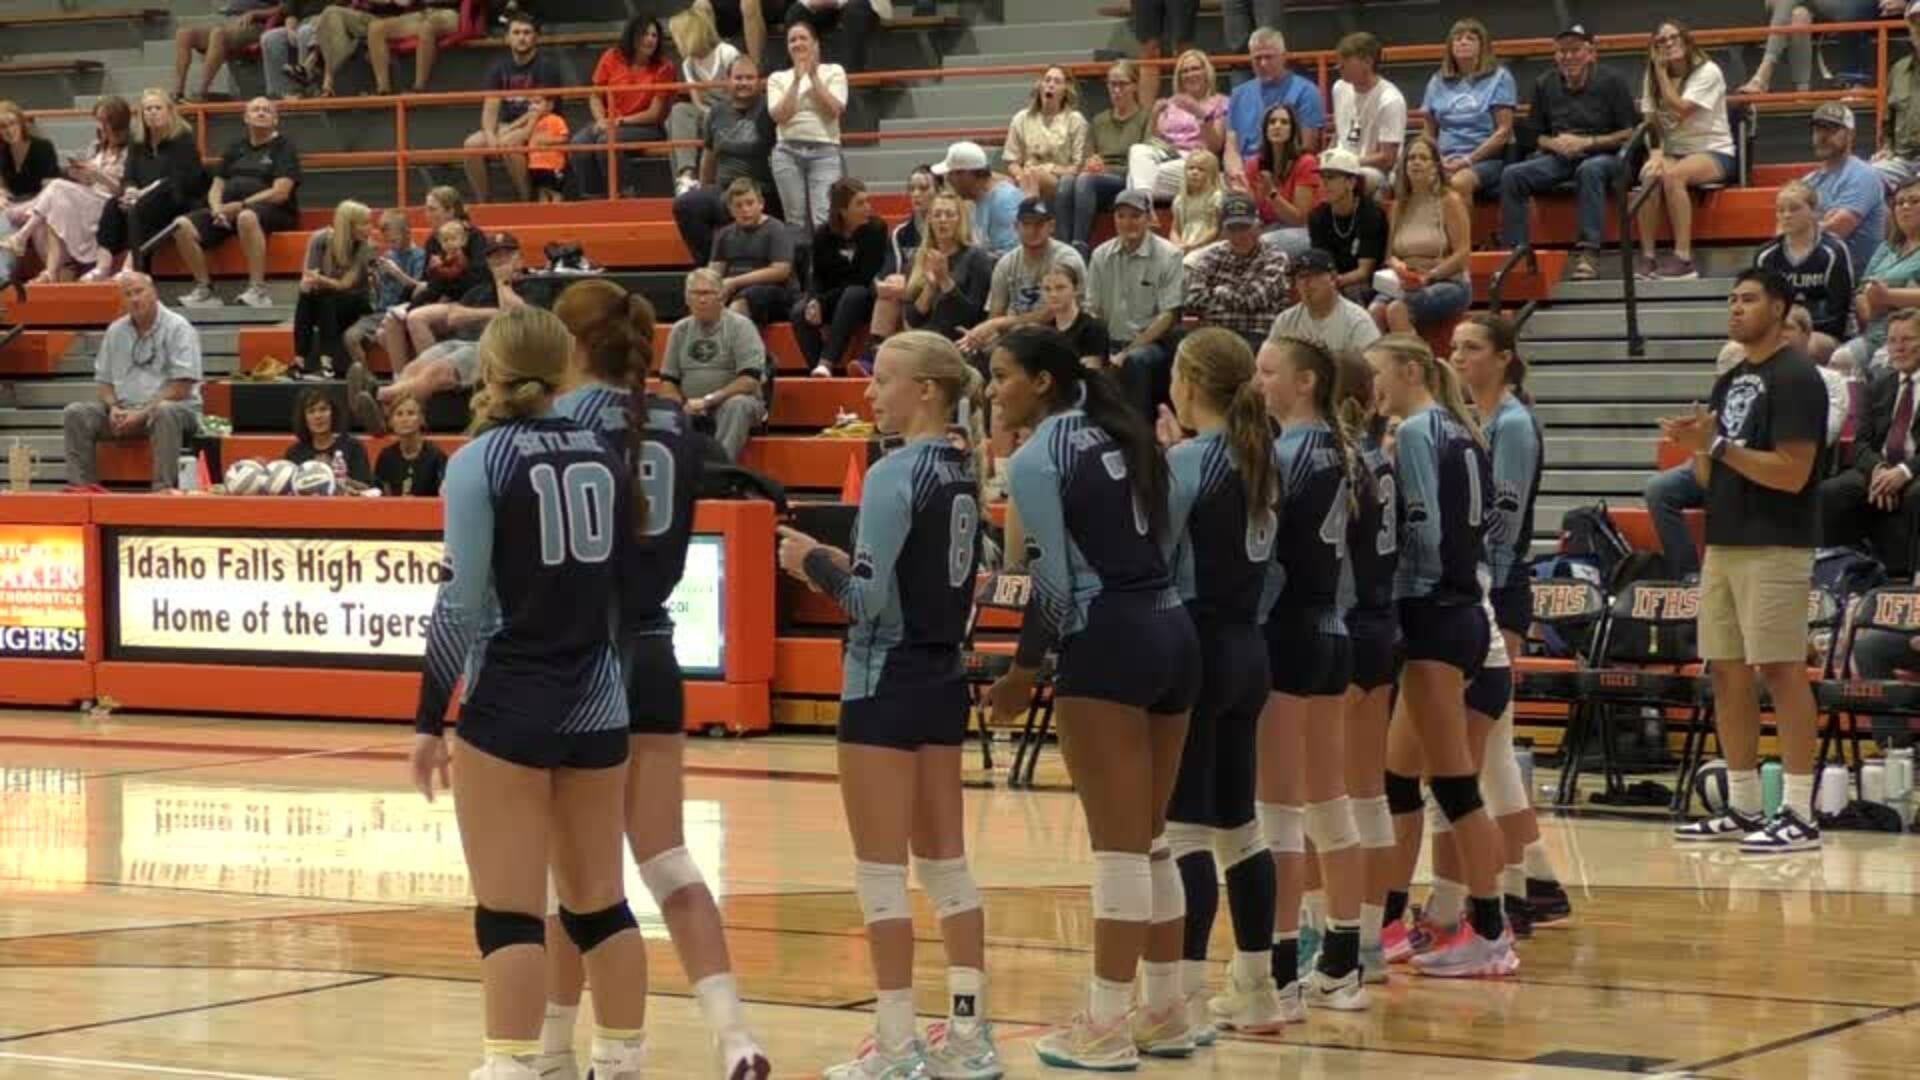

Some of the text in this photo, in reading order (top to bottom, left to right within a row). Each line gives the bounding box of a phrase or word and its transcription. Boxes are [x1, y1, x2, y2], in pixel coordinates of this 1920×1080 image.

[529, 461, 615, 565] 10
[1375, 472, 1397, 556] 3
[1464, 447, 1482, 527] 1
[127, 546, 207, 580] Idaho
[218, 547, 286, 582] Falls
[297, 549, 363, 593] High
[949, 493, 979, 588] 8
[153, 598, 433, 648] Home of the Tigers
[1632, 586, 1700, 619] IFHS
